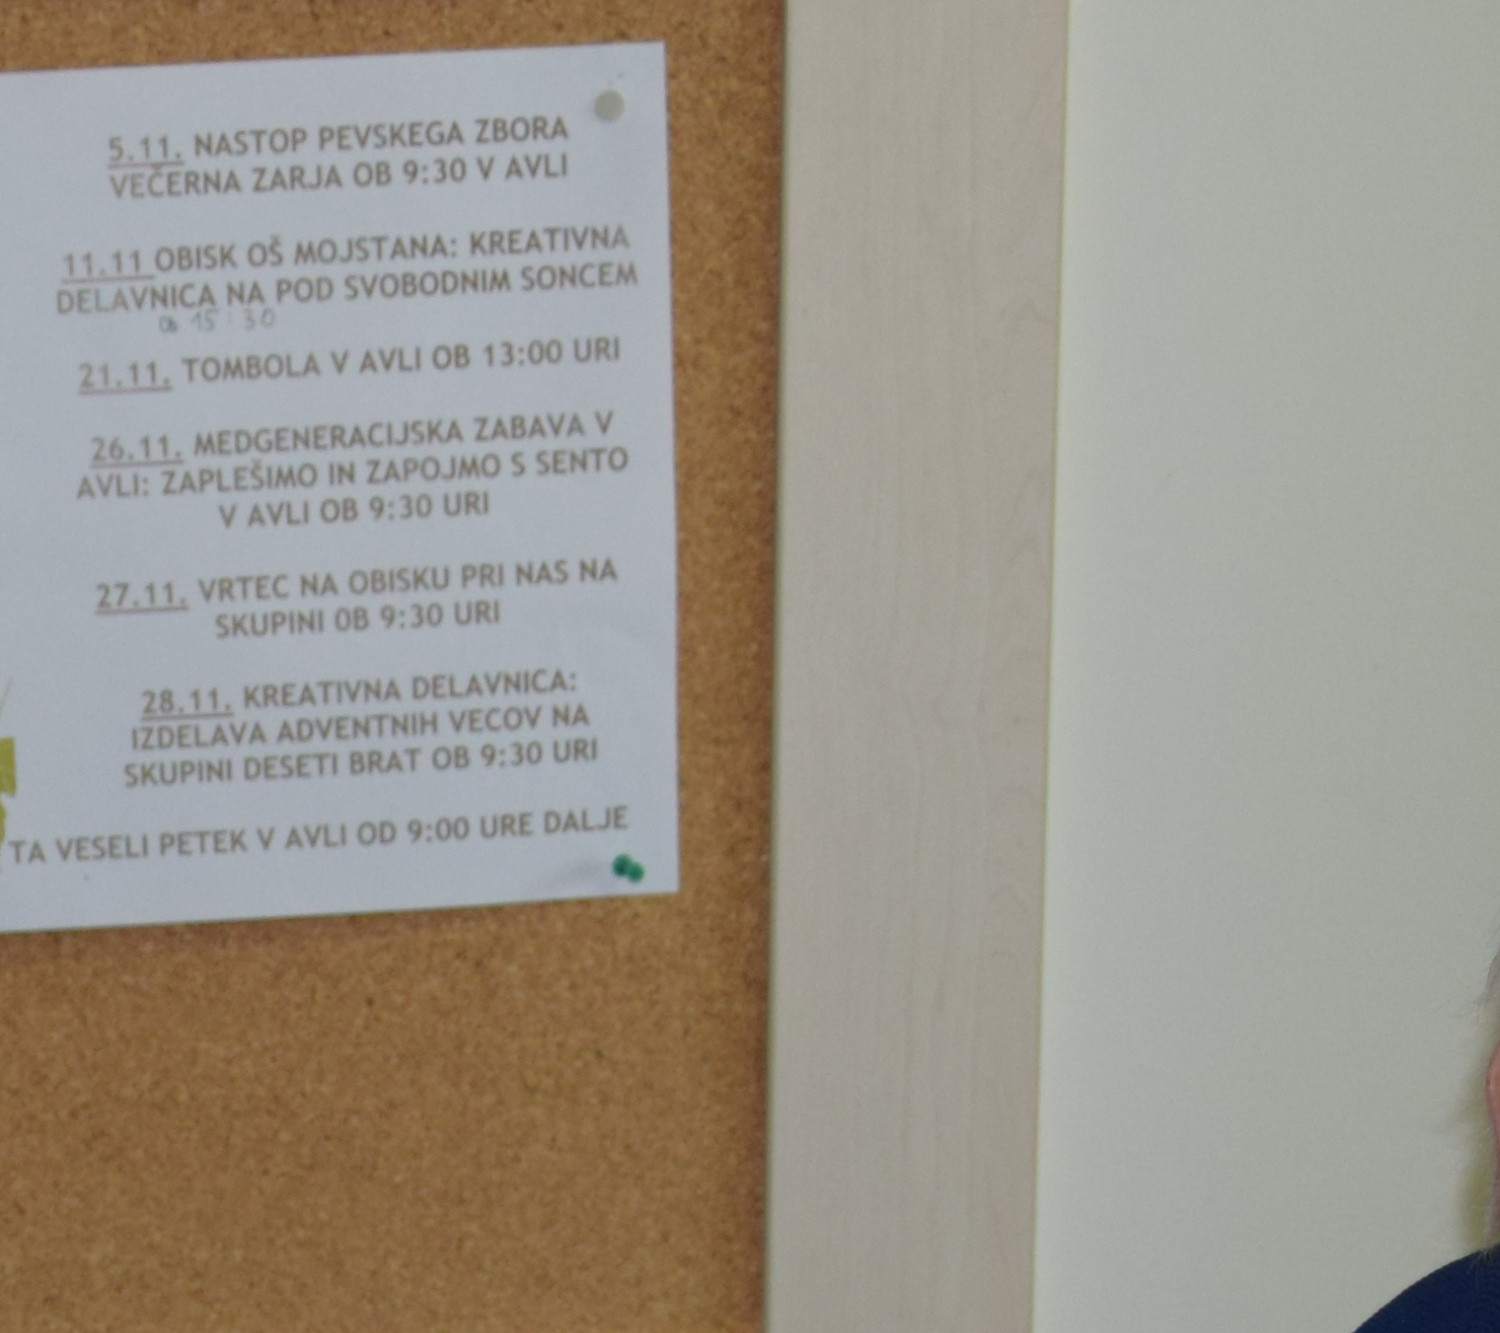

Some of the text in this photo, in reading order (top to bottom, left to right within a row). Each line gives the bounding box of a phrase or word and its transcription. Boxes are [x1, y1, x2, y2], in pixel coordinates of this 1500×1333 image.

[109, 115, 569, 165] 5.11. NASTOP PEVSKEGA ZBORA
[110, 152, 568, 199] VEČERNA ZARJA OB 9:30 V AVLI
[63, 225, 629, 278] 11.11 OBISK OŠ MOJSTANA: KREATIVNA
[56, 262, 637, 315] DELAVNICA NA POD SVOBODNIM SONCEM
[79, 336, 620, 390] 21.11. TOMBOLA V AVLI OB 13:00 URI
[92, 410, 613, 465] 26.11. MEDGENERACIJSKA ZABAVA V
[77, 446, 629, 499] AVLI: ZAPLEŠIMO IN ZAPOJMO S SENTO
[219, 491, 489, 528] V AVLI OB 9:30 URI
[96, 558, 618, 611] 27.11. VRTEC NA OBISKU PRI NAS NA
[215, 609, 324, 639] SKUPINI
[380, 603, 444, 629] 9:30
[454, 599, 500, 626] URI
[142, 668, 576, 716] 28.11. KREATIVNA DELAVNICA:
[131, 703, 590, 751] IZDELAVA ADVENTNIH VECOV NA
[124, 737, 598, 788] SKUPINI DESETI BRAT OB 9:30 URI
[8, 840, 46, 864] TA
[55, 834, 149, 862] VESELI
[159, 829, 248, 857] PETEK
[257, 827, 275, 851] V
[285, 823, 347, 849] AVLI
[356, 820, 397, 847] OD
[407, 816, 470, 843] 9:00
[480, 812, 533, 839] URE
[544, 805, 627, 835] DALJE
